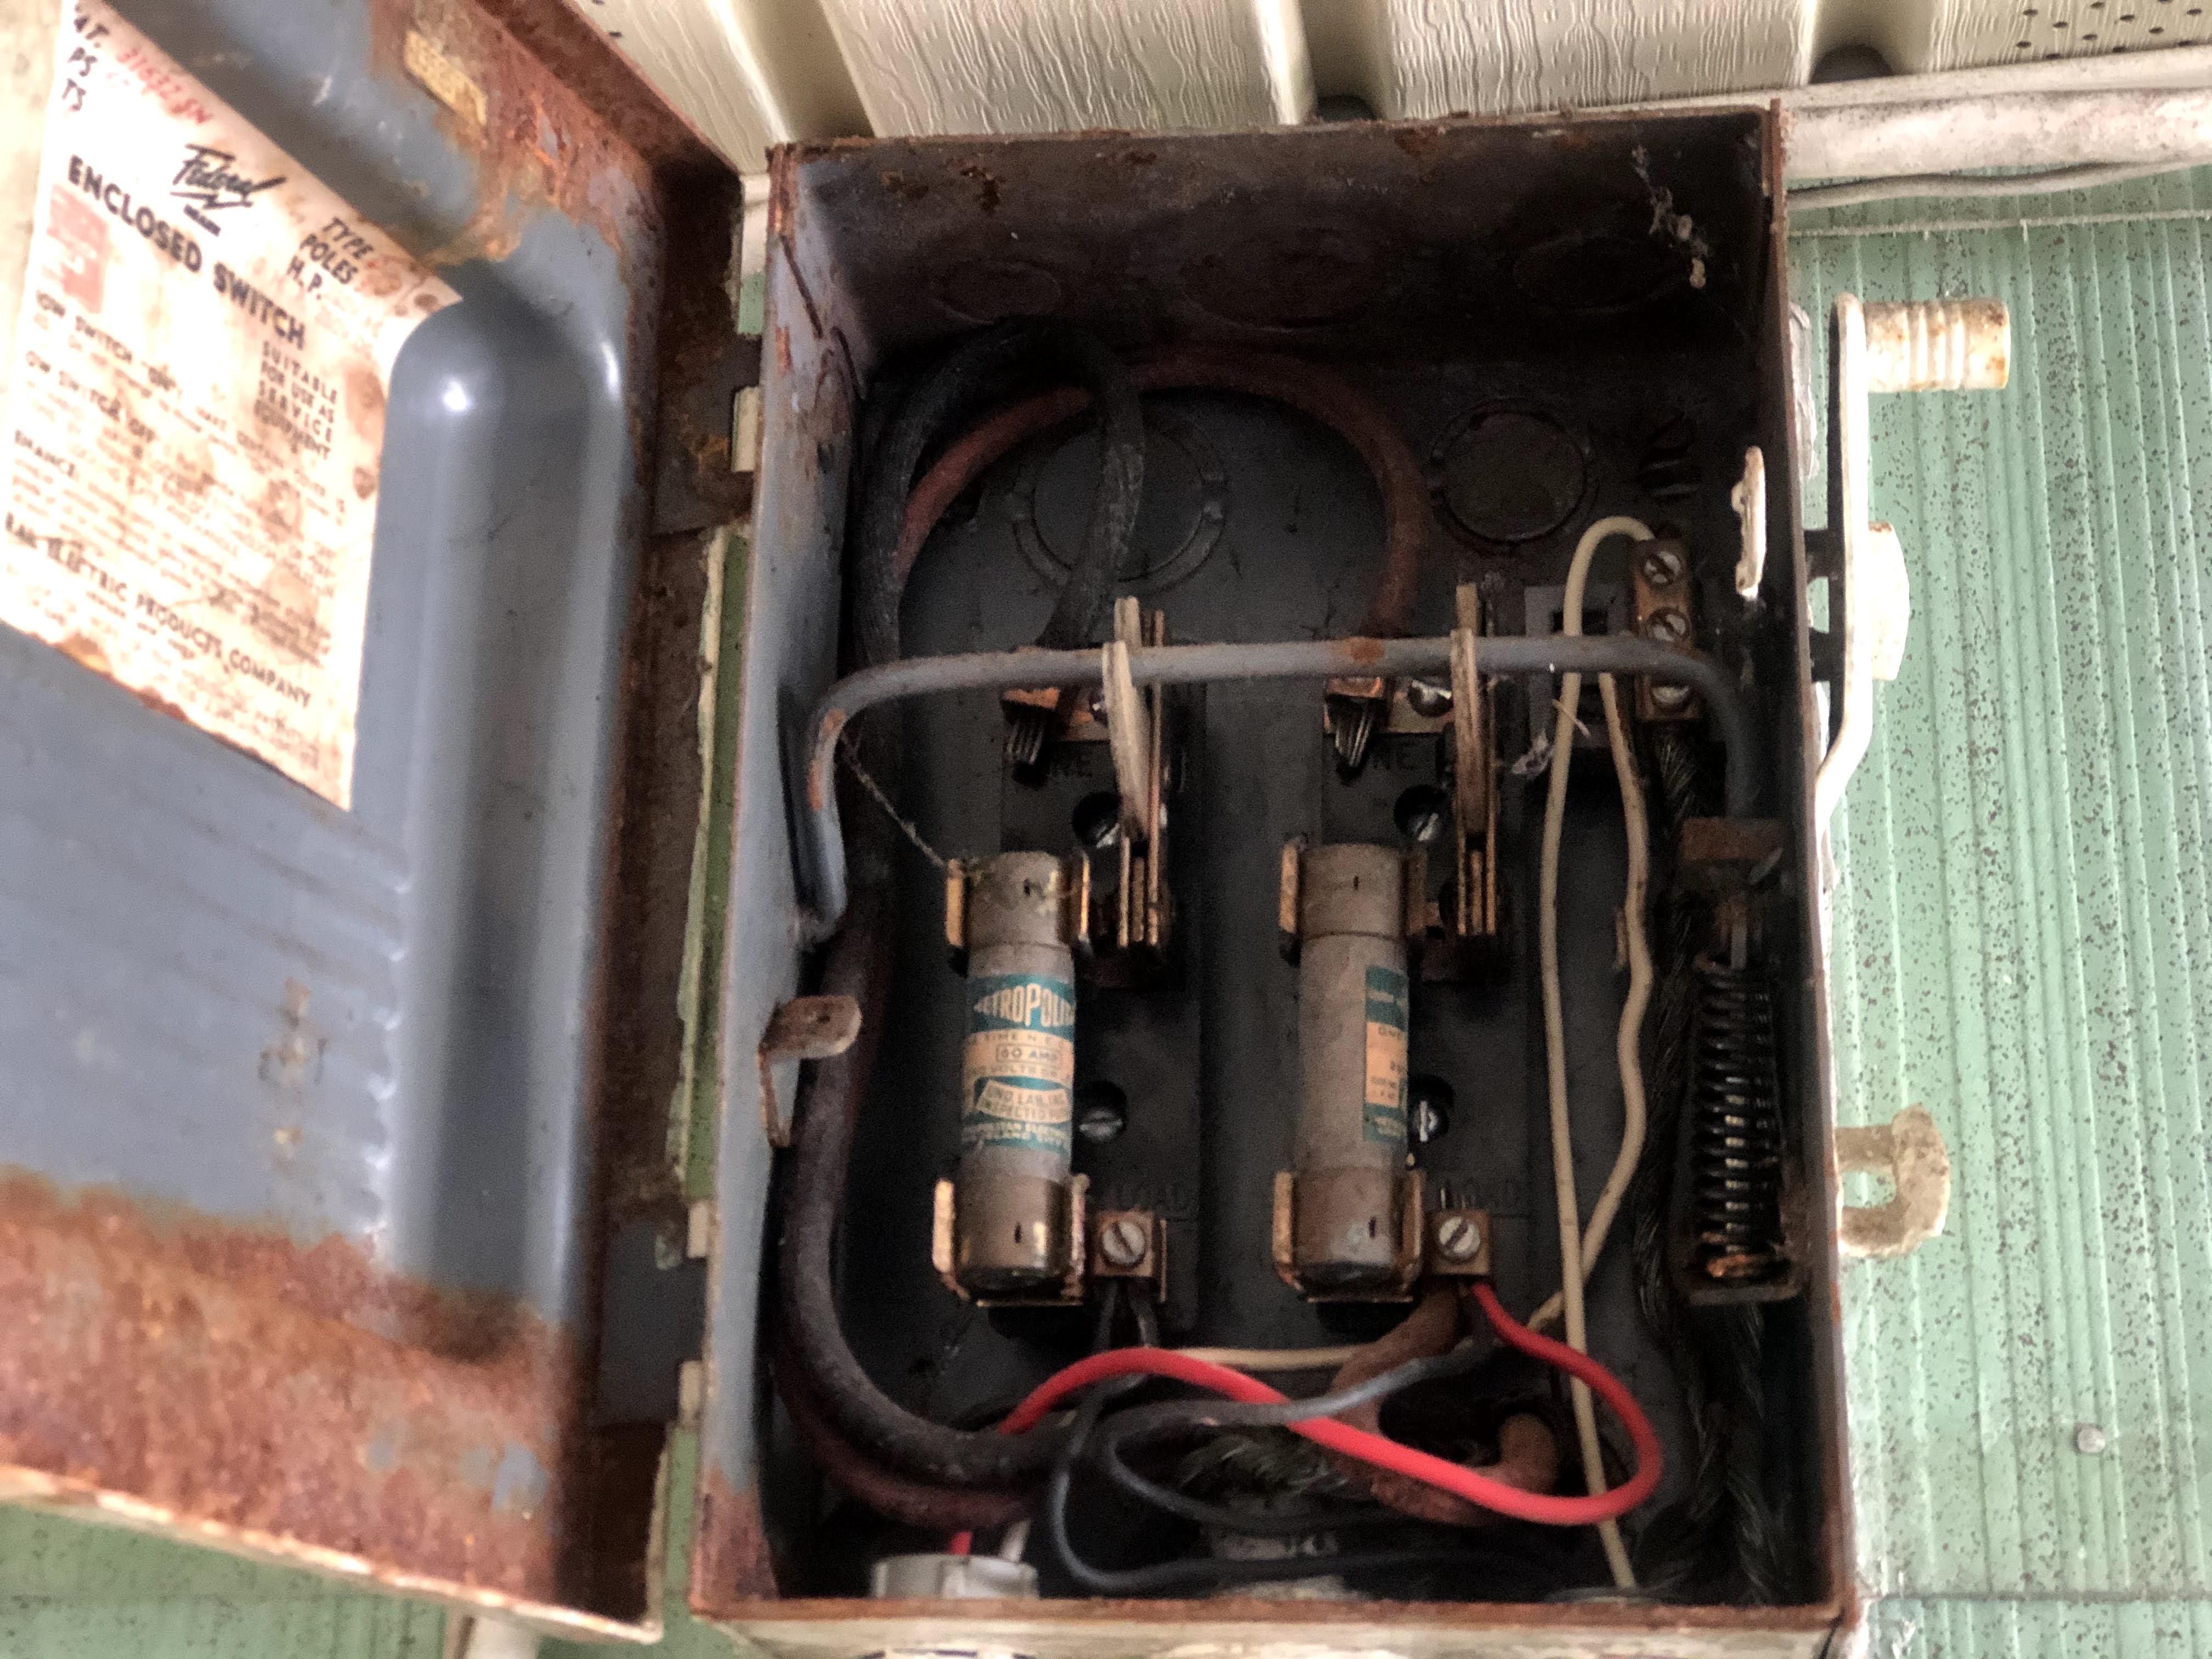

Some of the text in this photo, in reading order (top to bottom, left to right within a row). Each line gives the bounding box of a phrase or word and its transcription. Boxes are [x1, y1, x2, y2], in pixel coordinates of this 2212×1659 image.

[172, 143, 289, 196] Federal
[67, 154, 202, 273] ENCLOSED
[213, 260, 305, 351] SWITCH
[298, 233, 358, 285] POLES
[323, 217, 375, 259] TYPE
[286, 255, 323, 301] H.P.
[261, 360, 335, 423] FOR USE AS
[262, 340, 337, 404] SUITABLE
[259, 380, 332, 443] SERVICE
[136, 592, 223, 659] PRODUCTS
[229, 647, 311, 709] COMPANY
